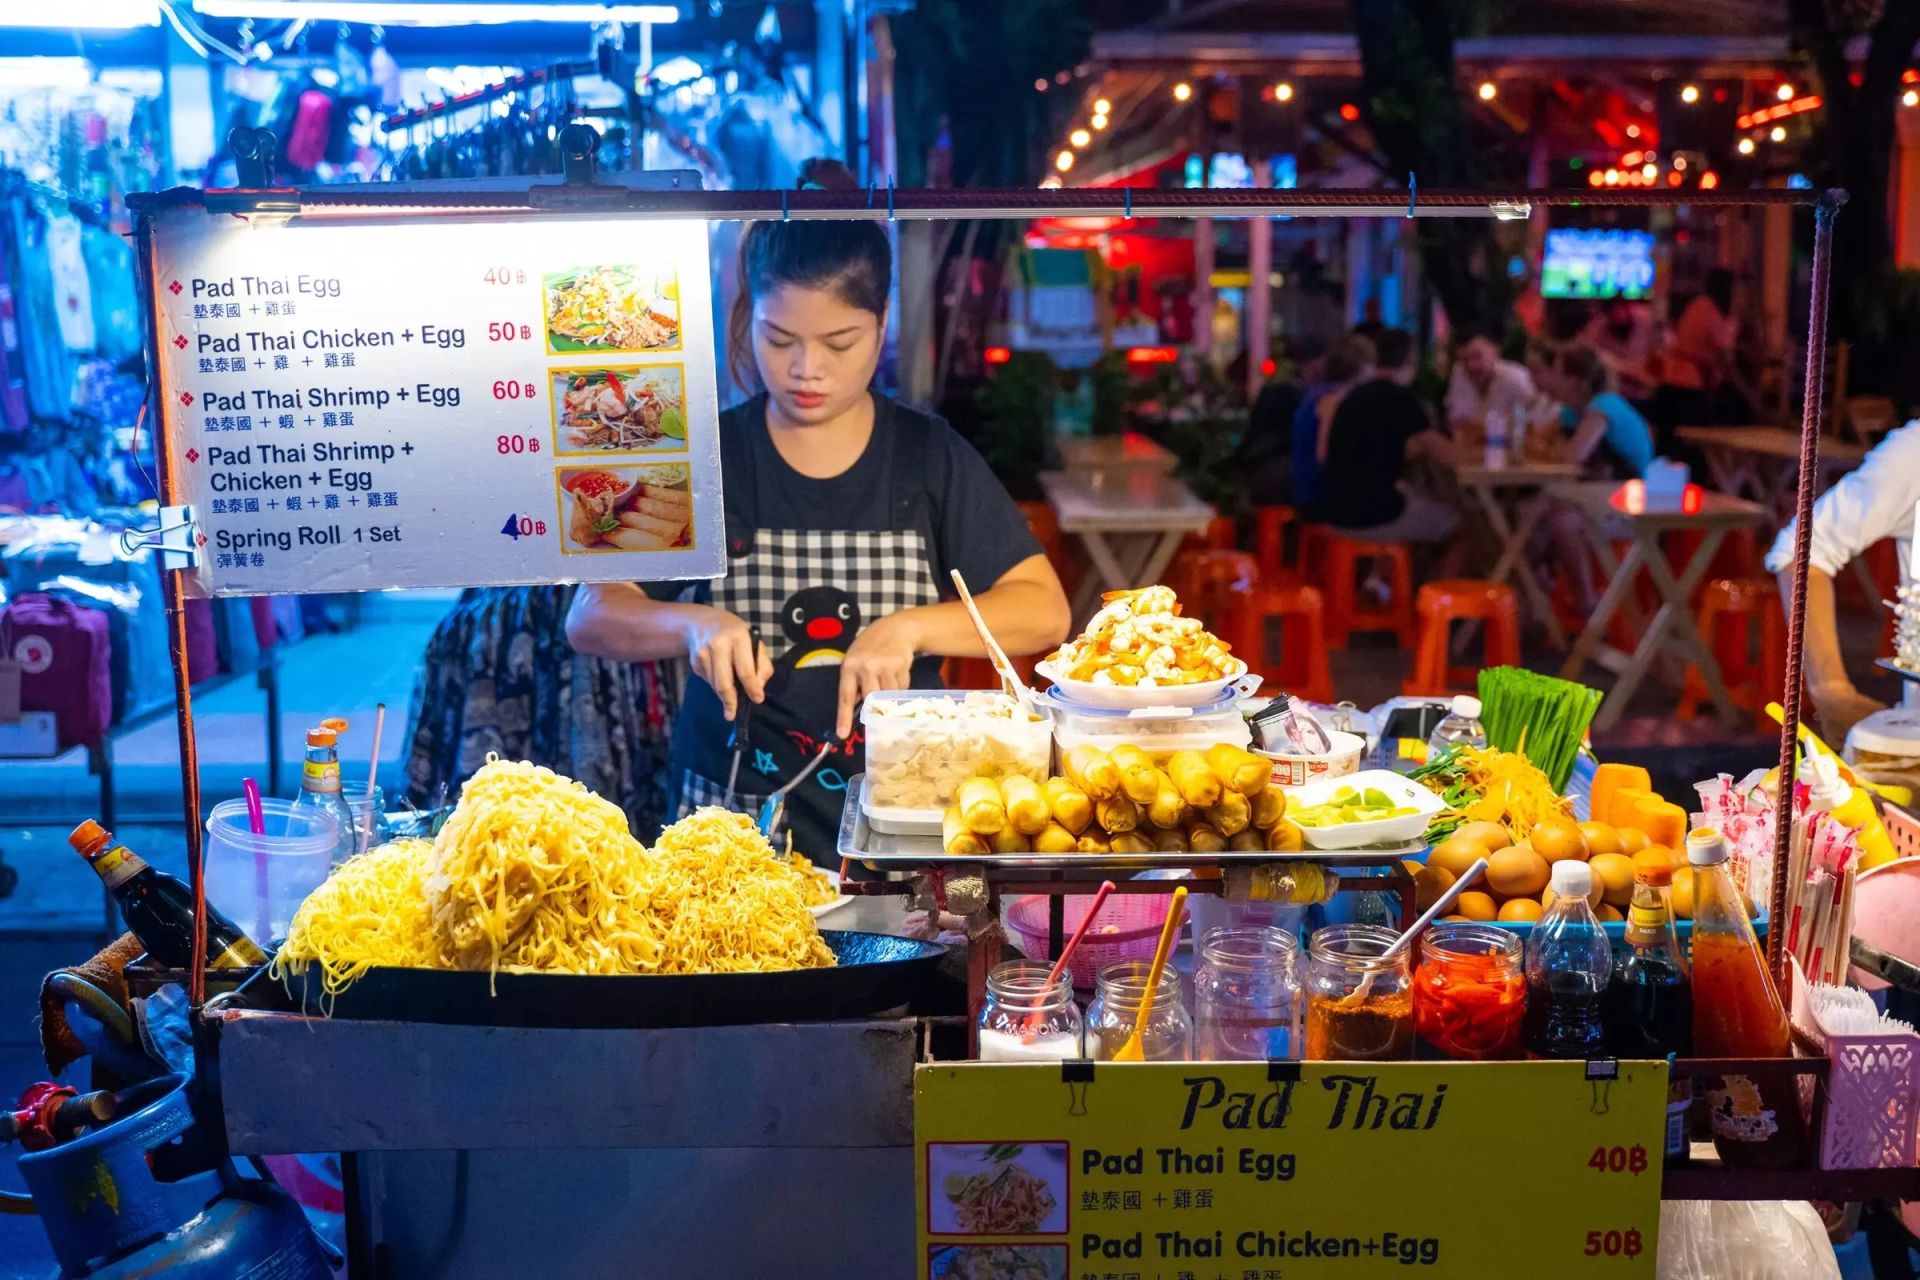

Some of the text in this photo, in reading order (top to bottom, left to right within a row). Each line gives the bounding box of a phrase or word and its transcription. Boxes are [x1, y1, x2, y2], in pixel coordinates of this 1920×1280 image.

[192, 275, 342, 298] Pad Thai Egg
[193, 302, 241, 319] 墊泰國
[265, 300, 297, 317] 雞蛋
[197, 333, 240, 353] Pad
[246, 330, 295, 351] Thai
[303, 327, 394, 349] Chicken
[422, 325, 465, 347] Egg
[198, 356, 245, 373] 墊泰國
[274, 354, 289, 371] 雞
[324, 352, 356, 369] 雞蛋
[203, 392, 245, 411] Pad
[252, 389, 300, 409] Thai
[308, 387, 389, 410] Shrimp
[417, 384, 460, 407] Egg
[204, 416, 252, 432] 墊泰國
[279, 414, 295, 430] 蝦
[323, 412, 355, 428] 雞蛋
[208, 445, 251, 466] Pad
[257, 443, 306, 464] Thai
[313, 441, 395, 463] Shrimp
[210, 470, 302, 492] Chicken
[329, 468, 373, 491] Egg
[212, 497, 260, 514] 墊泰國
[286, 496, 302, 511] 蝦
[324, 494, 341, 510] 雞
[367, 491, 399, 508] 雞蛋
[216, 525, 402, 552] Spring Roll 1 Set
[216, 552, 264, 568] 彈簧卷
[1119, 1021, 1174, 1036] MSON
[1180, 1075, 1448, 1131] Pad Thai
[1082, 1147, 1296, 1181] Pad Thai Egg
[1080, 1190, 1142, 1211] 墊泰國
[1173, 1189, 1215, 1210] 雞蛋
[1082, 1230, 1439, 1265] Pad Thai Chicken+Egg
